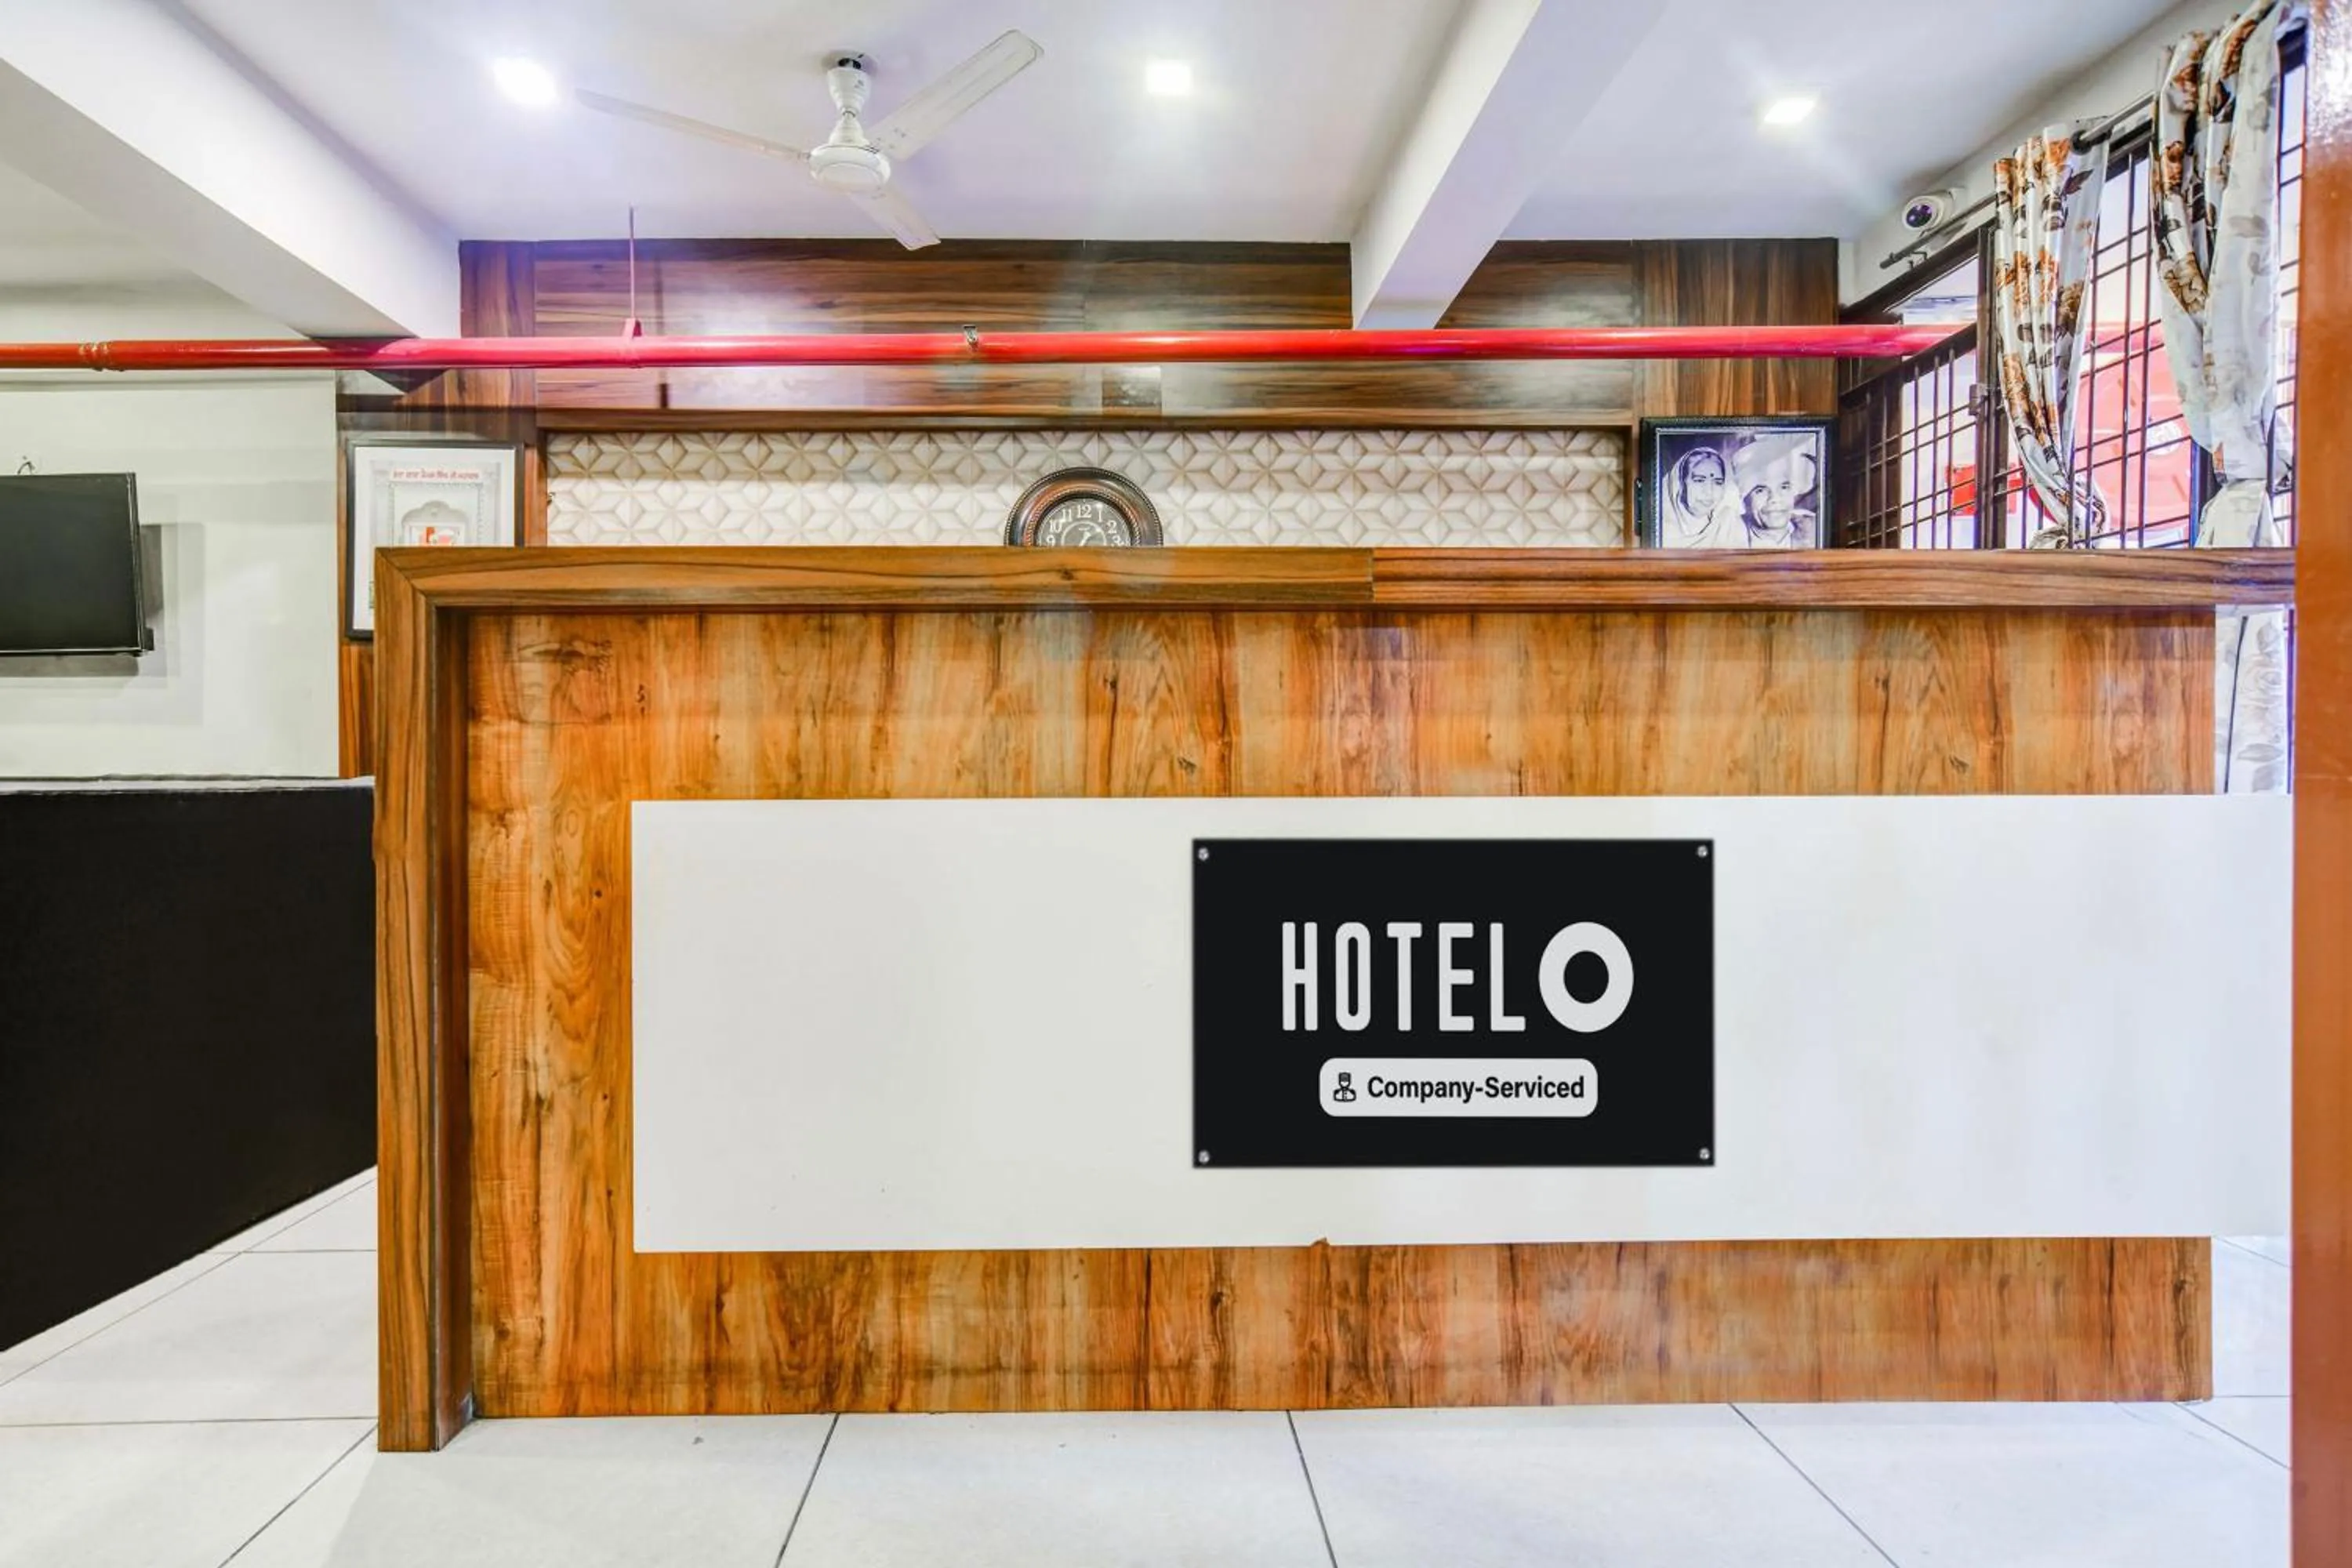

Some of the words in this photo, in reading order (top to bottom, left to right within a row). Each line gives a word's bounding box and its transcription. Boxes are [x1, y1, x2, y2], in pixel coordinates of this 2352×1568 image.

[1062, 508, 1073, 522] 11
[1077, 504, 1092, 518] 12
[1050, 519, 1063, 533] 10
[1107, 520, 1117, 534] 2
[1367, 1076, 1584, 1103] Company-Serviced
